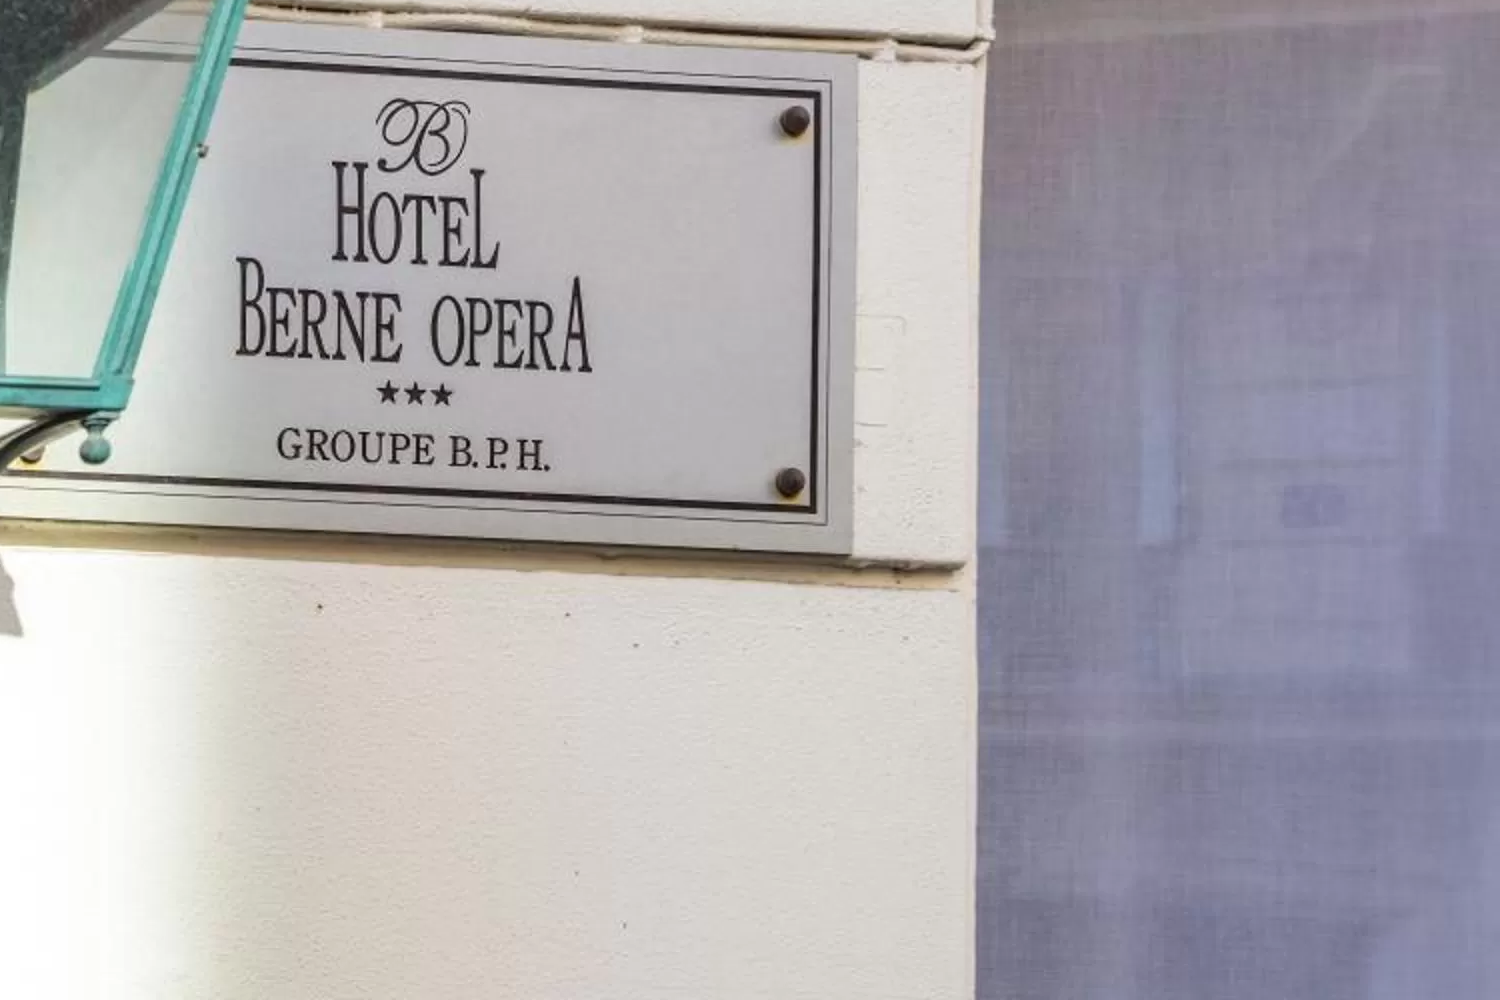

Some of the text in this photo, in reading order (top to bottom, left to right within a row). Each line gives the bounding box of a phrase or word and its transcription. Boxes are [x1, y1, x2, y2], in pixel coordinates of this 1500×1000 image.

[331, 160, 501, 270] HOTEL
[235, 256, 593, 374] BERNE OPERA
[276, 426, 436, 467] GROUPE
